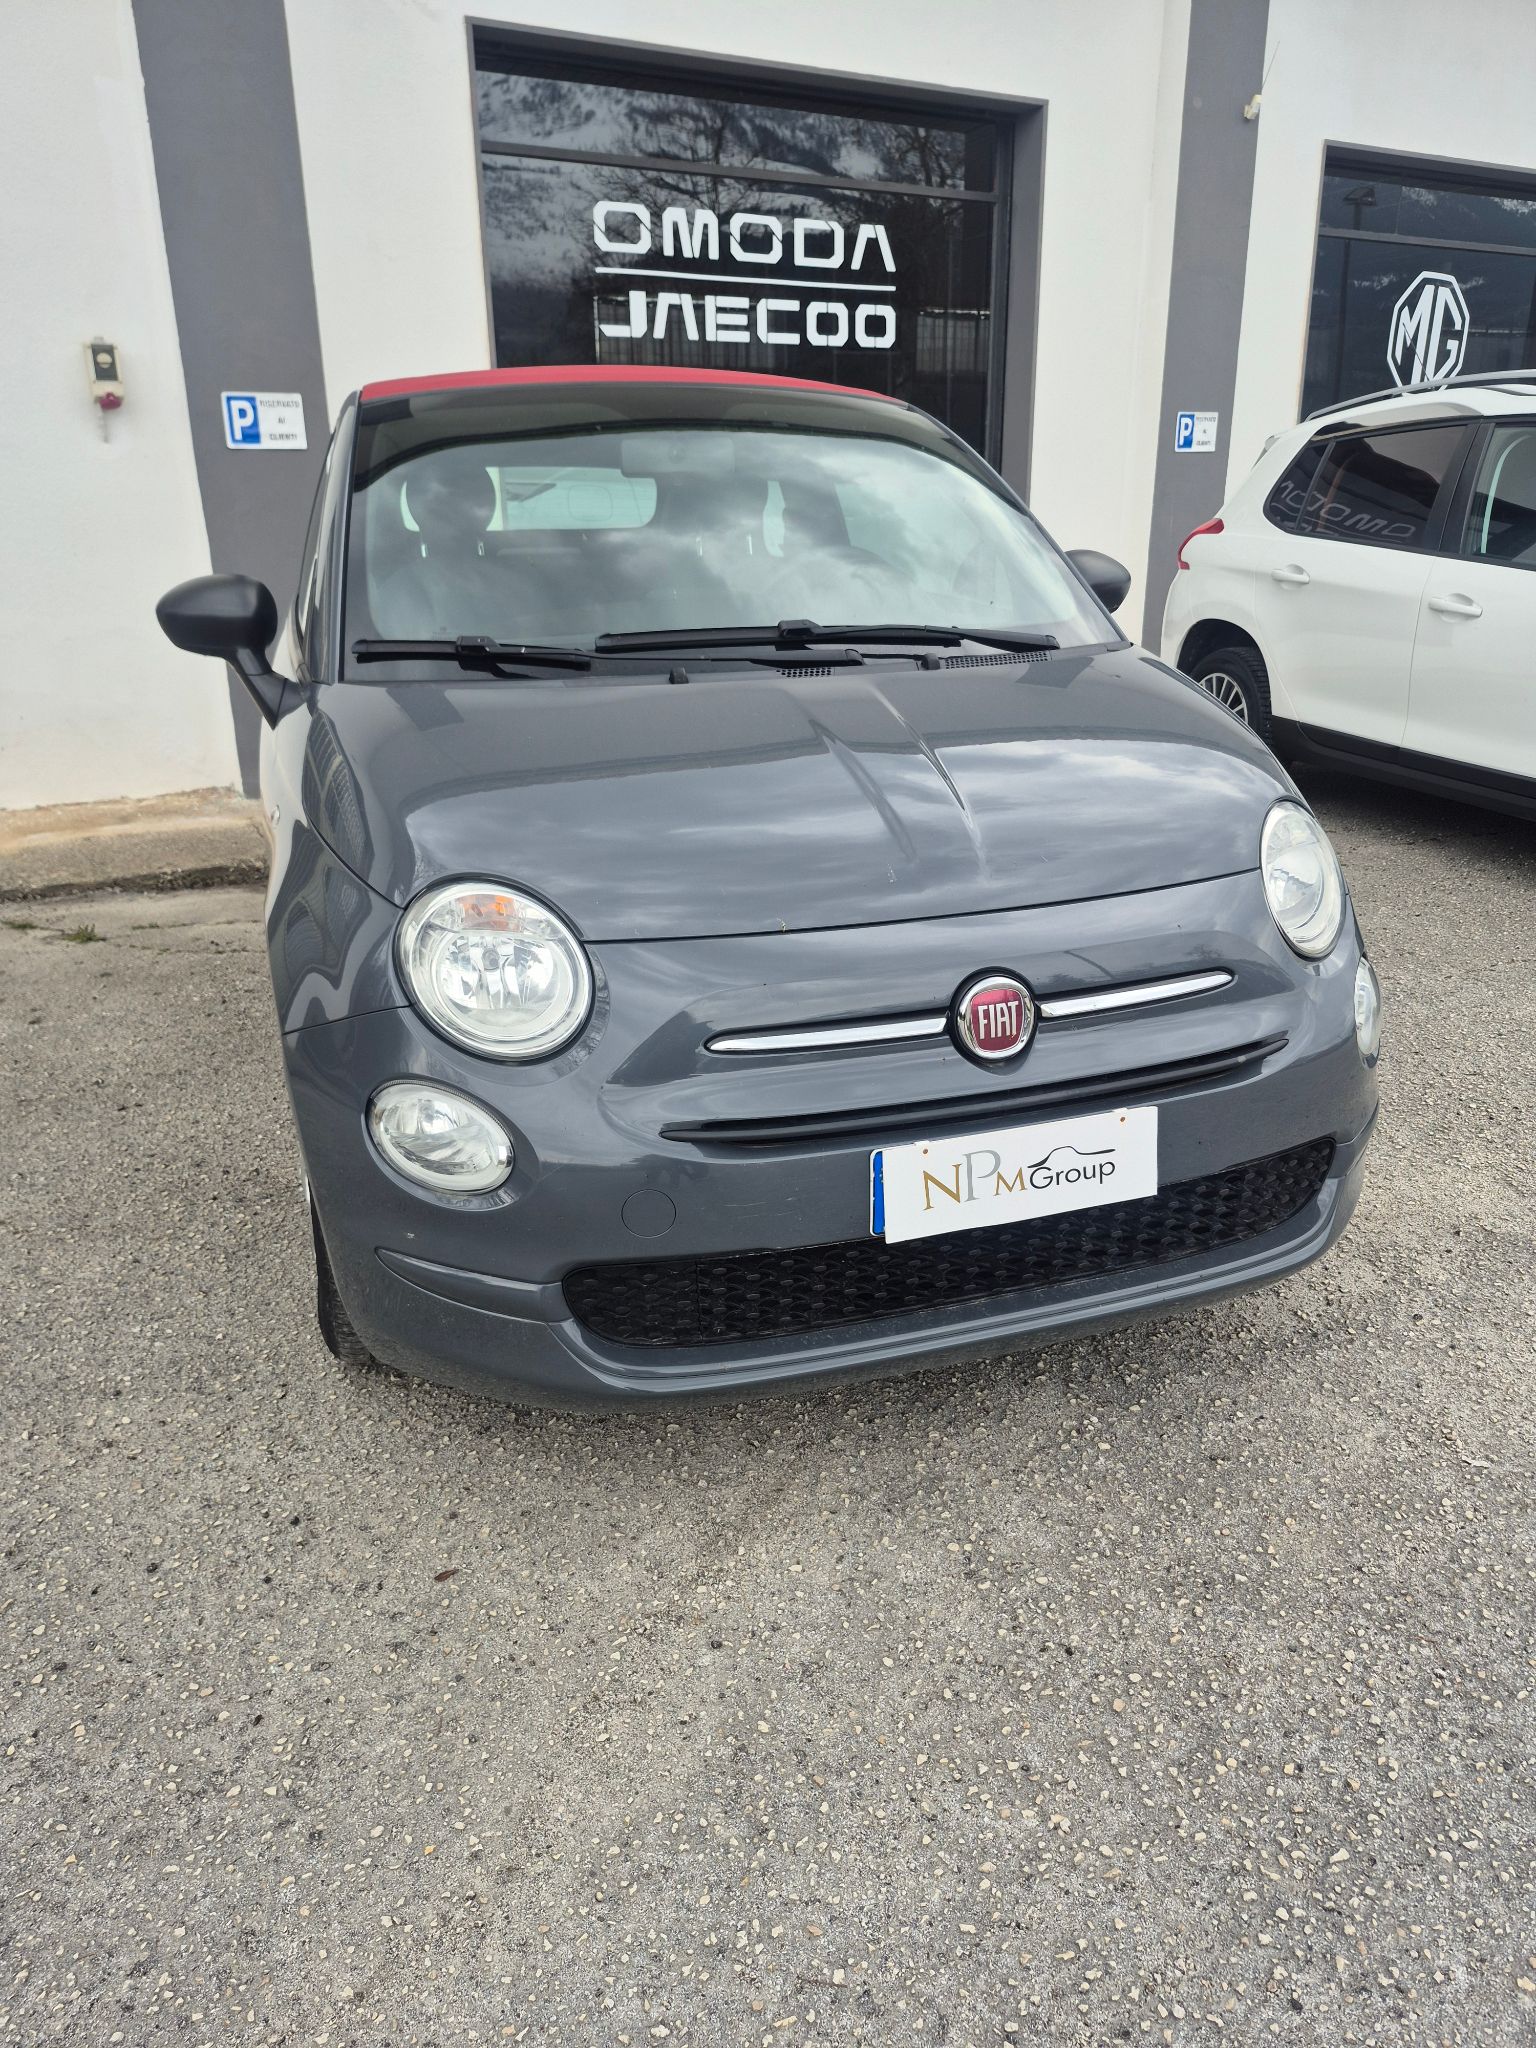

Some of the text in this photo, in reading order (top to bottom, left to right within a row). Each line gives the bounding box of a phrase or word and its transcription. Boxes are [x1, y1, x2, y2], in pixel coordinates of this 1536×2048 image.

[593, 200, 897, 273] OMODA
[599, 290, 897, 349] JAECOO
[1395, 284, 1463, 385] MG
[230, 399, 255, 441] P
[1179, 417, 1192, 446] P
[977, 1000, 1019, 1040] FIAT
